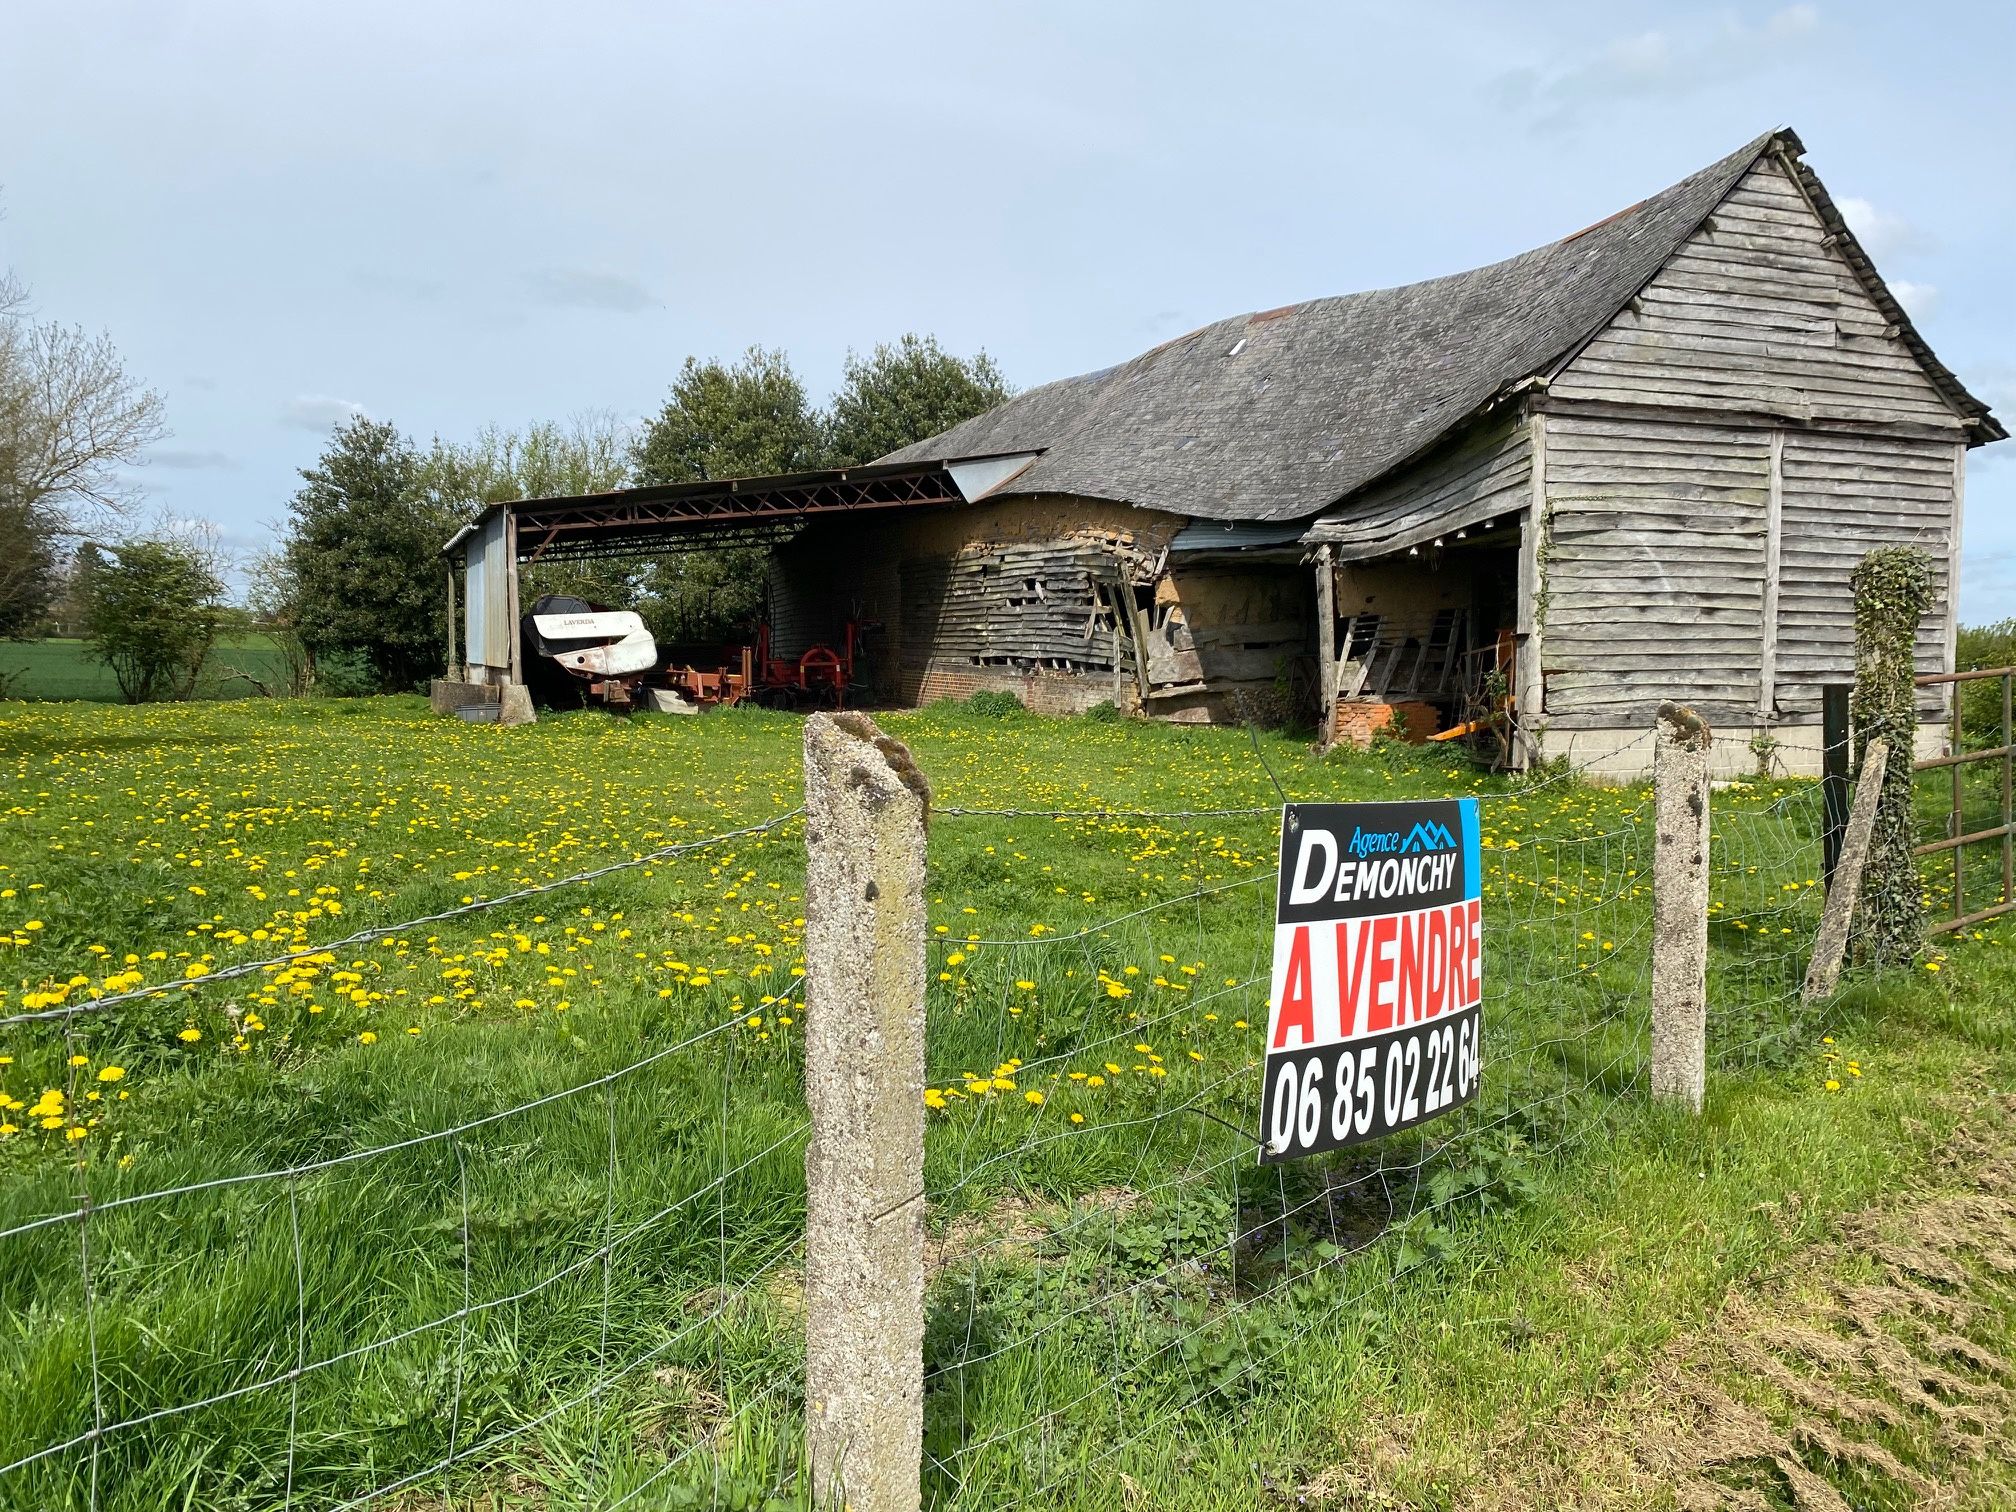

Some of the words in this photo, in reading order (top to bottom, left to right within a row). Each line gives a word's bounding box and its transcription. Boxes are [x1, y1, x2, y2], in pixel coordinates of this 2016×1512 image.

[563, 618, 595, 626] LAVERDA
[1289, 829, 1456, 905] DEMONCHY
[1349, 825, 1399, 858] Agence
[1273, 926, 1314, 1048] A
[1336, 901, 1479, 1037] VENDRE
[1272, 1056, 1324, 1154] 06
[1331, 1046, 1378, 1141] 85
[1384, 1036, 1421, 1127] 02
[1424, 1025, 1454, 1113] 22
[1458, 1013, 1479, 1098] 64
